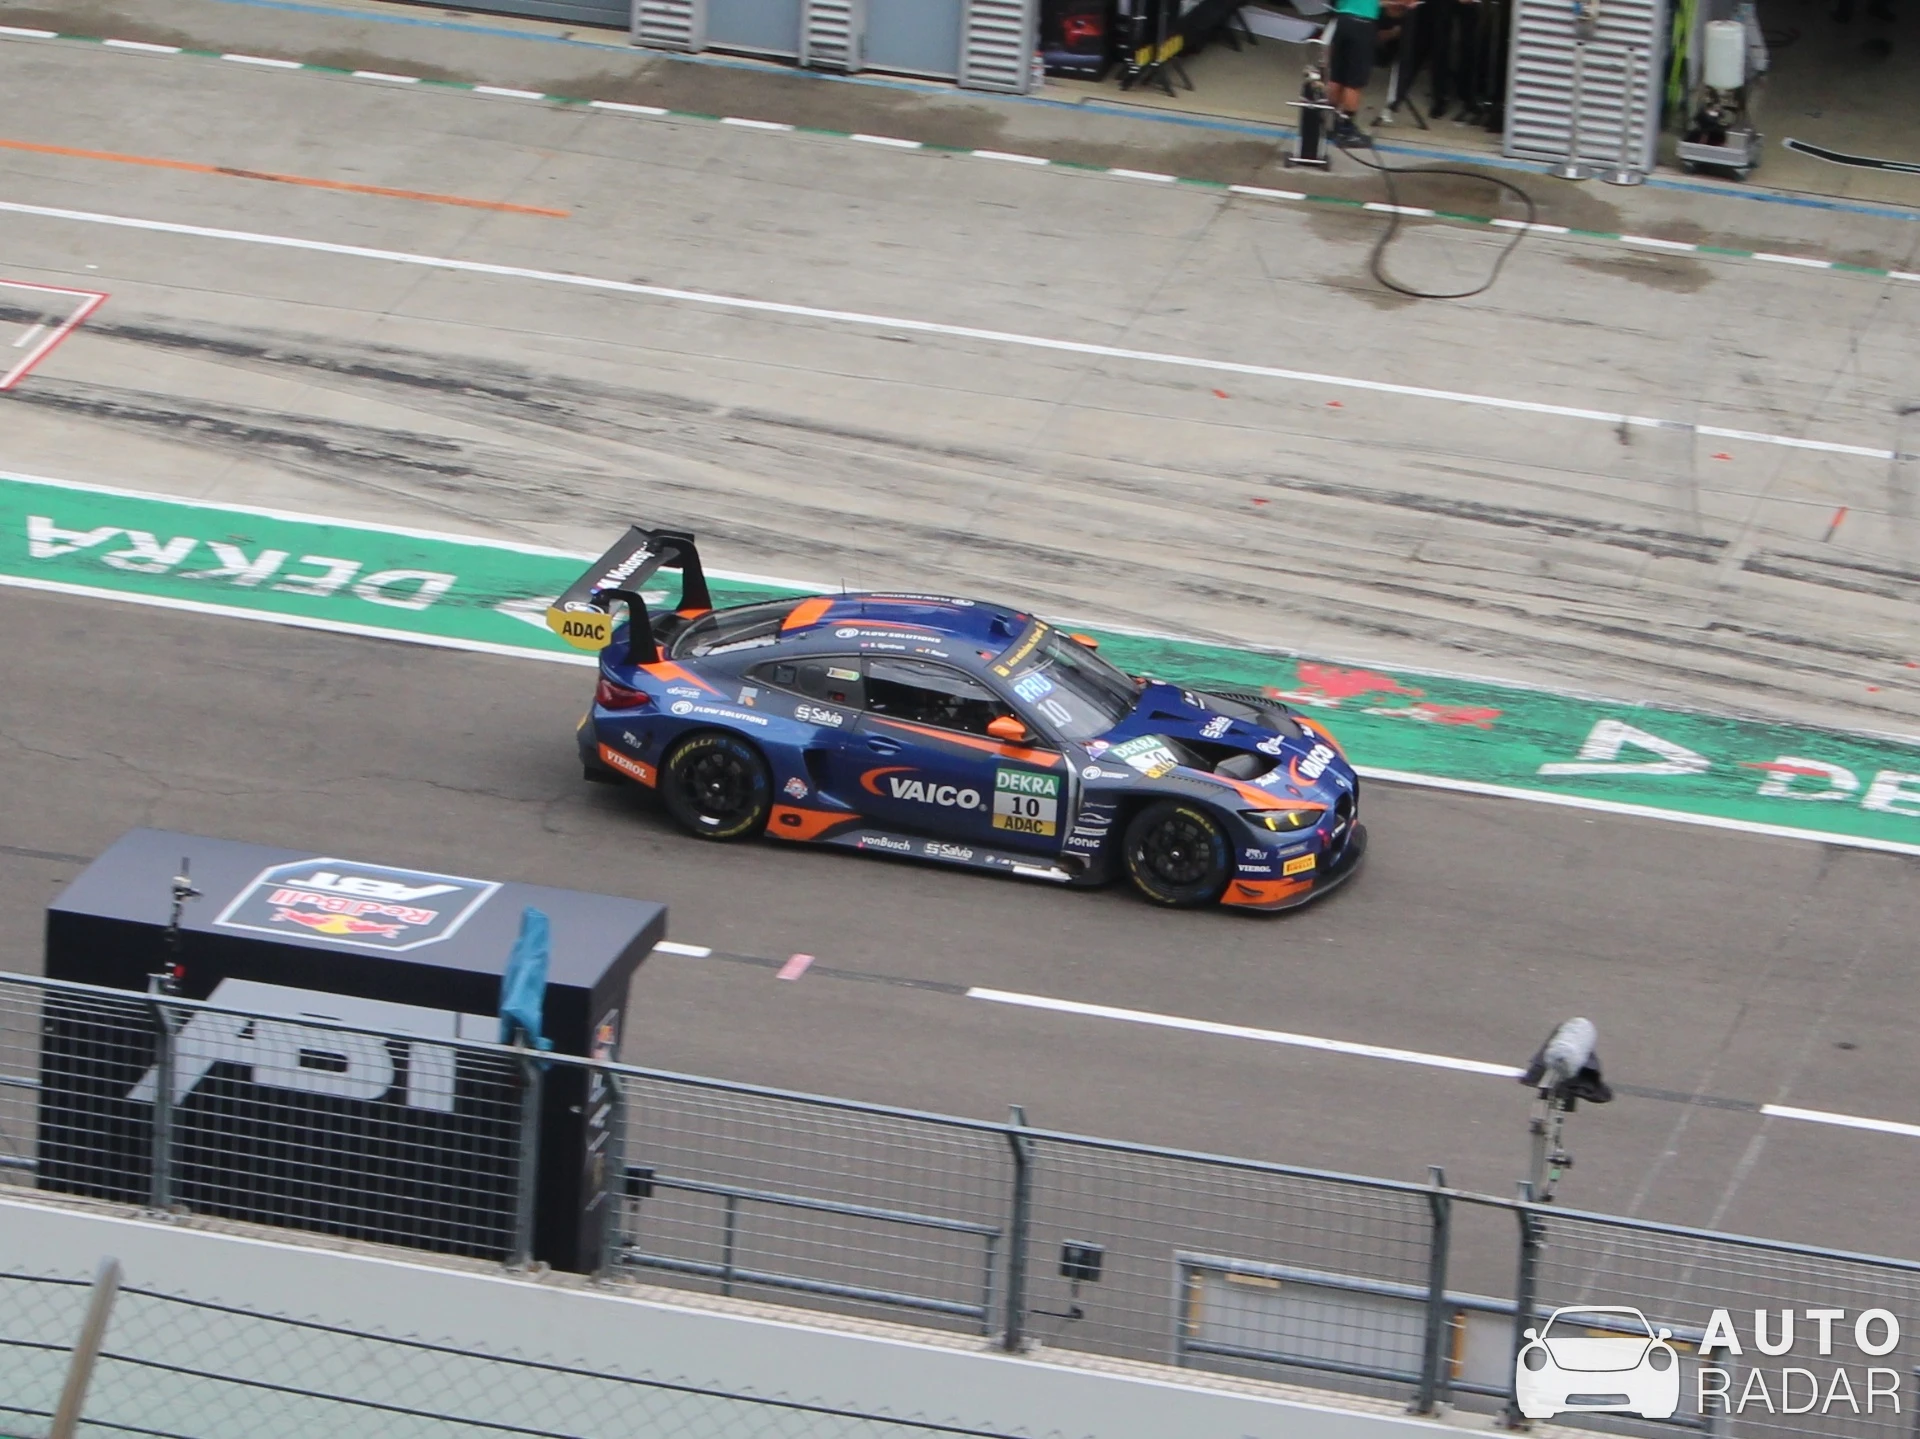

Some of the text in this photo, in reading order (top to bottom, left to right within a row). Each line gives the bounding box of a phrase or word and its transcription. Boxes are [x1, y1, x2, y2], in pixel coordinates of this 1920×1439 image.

[26, 515, 458, 611] DEKRA
[562, 621, 605, 640] ADAC
[888, 633, 941, 643] SOLUTIONS
[1014, 672, 1052, 703] RAU
[693, 706, 768, 726] FLOW SOLUTIONS
[811, 708, 843, 725] Salvia
[1037, 699, 1072, 728] 10
[1111, 736, 1162, 758] DEKRA
[606, 750, 647, 778] VIEROL
[1298, 744, 1335, 779] VAICO
[889, 777, 980, 810] VAICO
[996, 771, 1056, 796] DEKRA
[1012, 796, 1040, 817] 10
[1004, 816, 1043, 833] ADAC
[861, 836, 911, 851] vonBusch
[940, 844, 974, 859] Salvia
[286, 871, 463, 900] ABT
[267, 888, 439, 925] Red Bull
